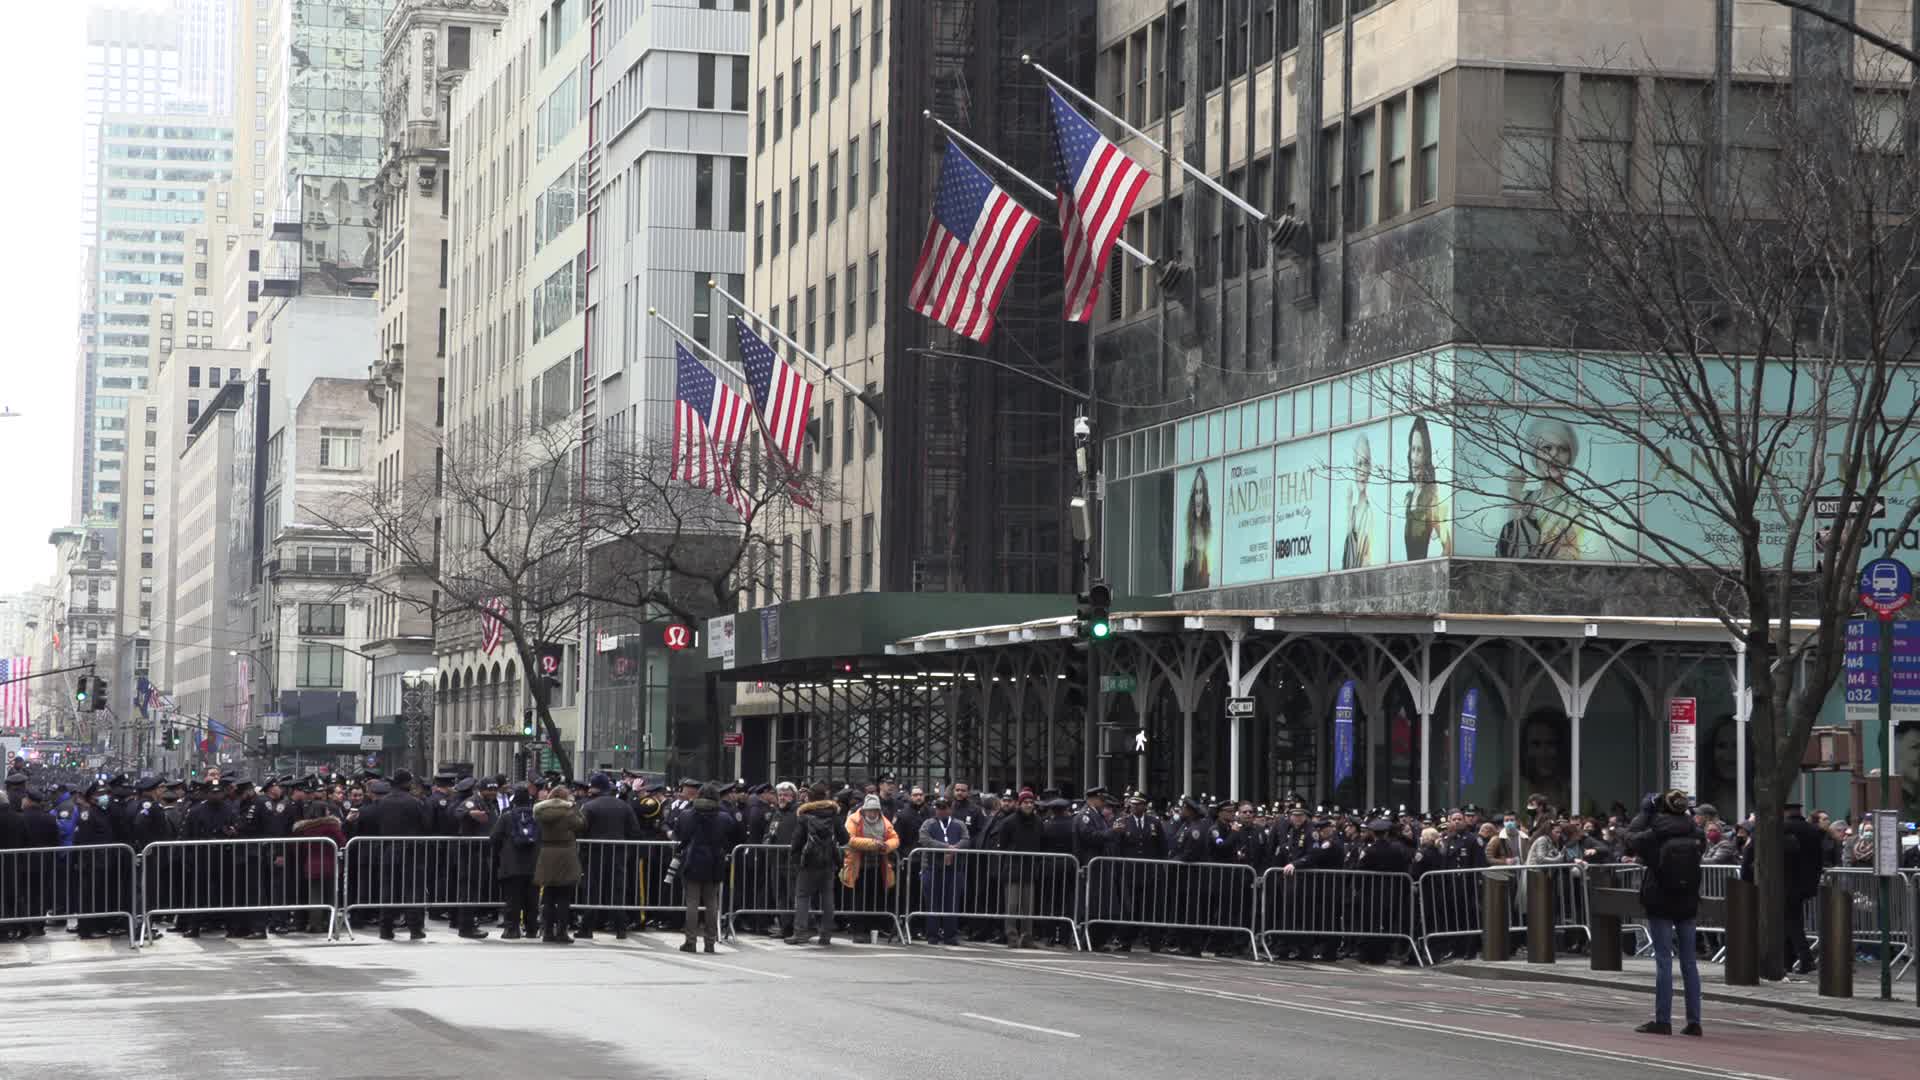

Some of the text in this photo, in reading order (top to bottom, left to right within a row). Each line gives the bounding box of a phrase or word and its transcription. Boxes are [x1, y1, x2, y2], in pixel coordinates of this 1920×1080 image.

[1227, 480, 1258, 516] AND
[1847, 656, 1864, 668] M4
[1848, 673, 1865, 685] M4
